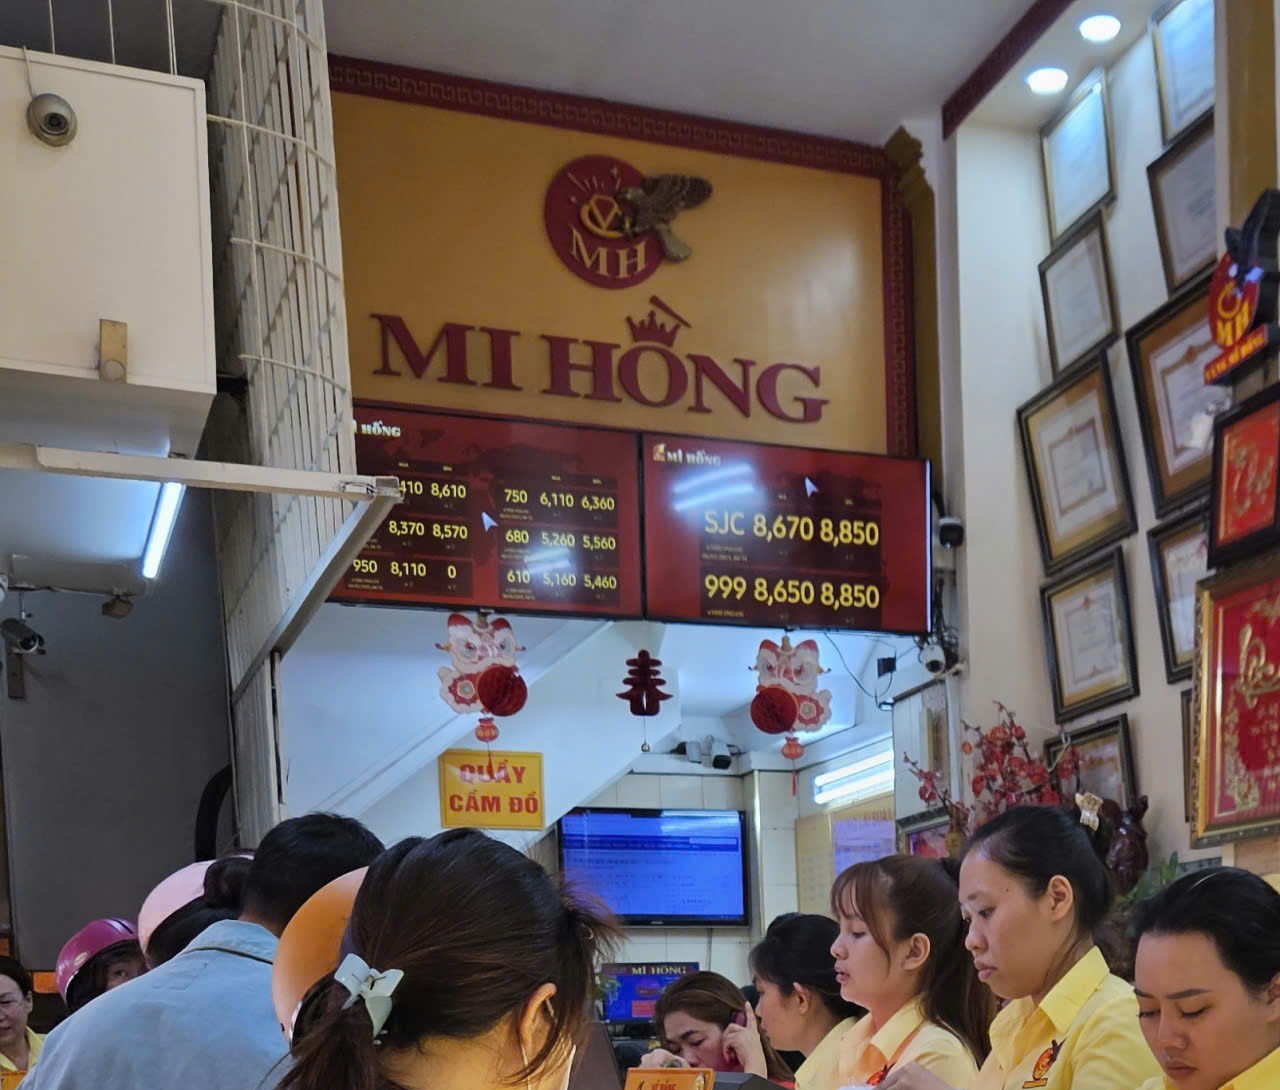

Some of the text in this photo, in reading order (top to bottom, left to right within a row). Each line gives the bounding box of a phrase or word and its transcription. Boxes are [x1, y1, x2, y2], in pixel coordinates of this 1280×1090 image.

[569, 222, 648, 278] MH
[370, 313, 522, 392] MI
[431, 483, 466, 499] 8,610
[504, 489, 615, 511] 750 6,110 6,360
[389, 520, 468, 540] 8,370 8,570
[505, 530, 616, 550] 680 5,260 5,560
[704, 510, 879, 548] SJC 8,670 8,850
[353, 560, 457, 579] 950 8,110 0
[507, 569, 617, 590] 610 5,160 5,460
[704, 574, 880, 611] 999 8,650 8,850
[459, 758, 526, 784] QUẦY
[449, 789, 539, 813] CẦM ĐỒ
